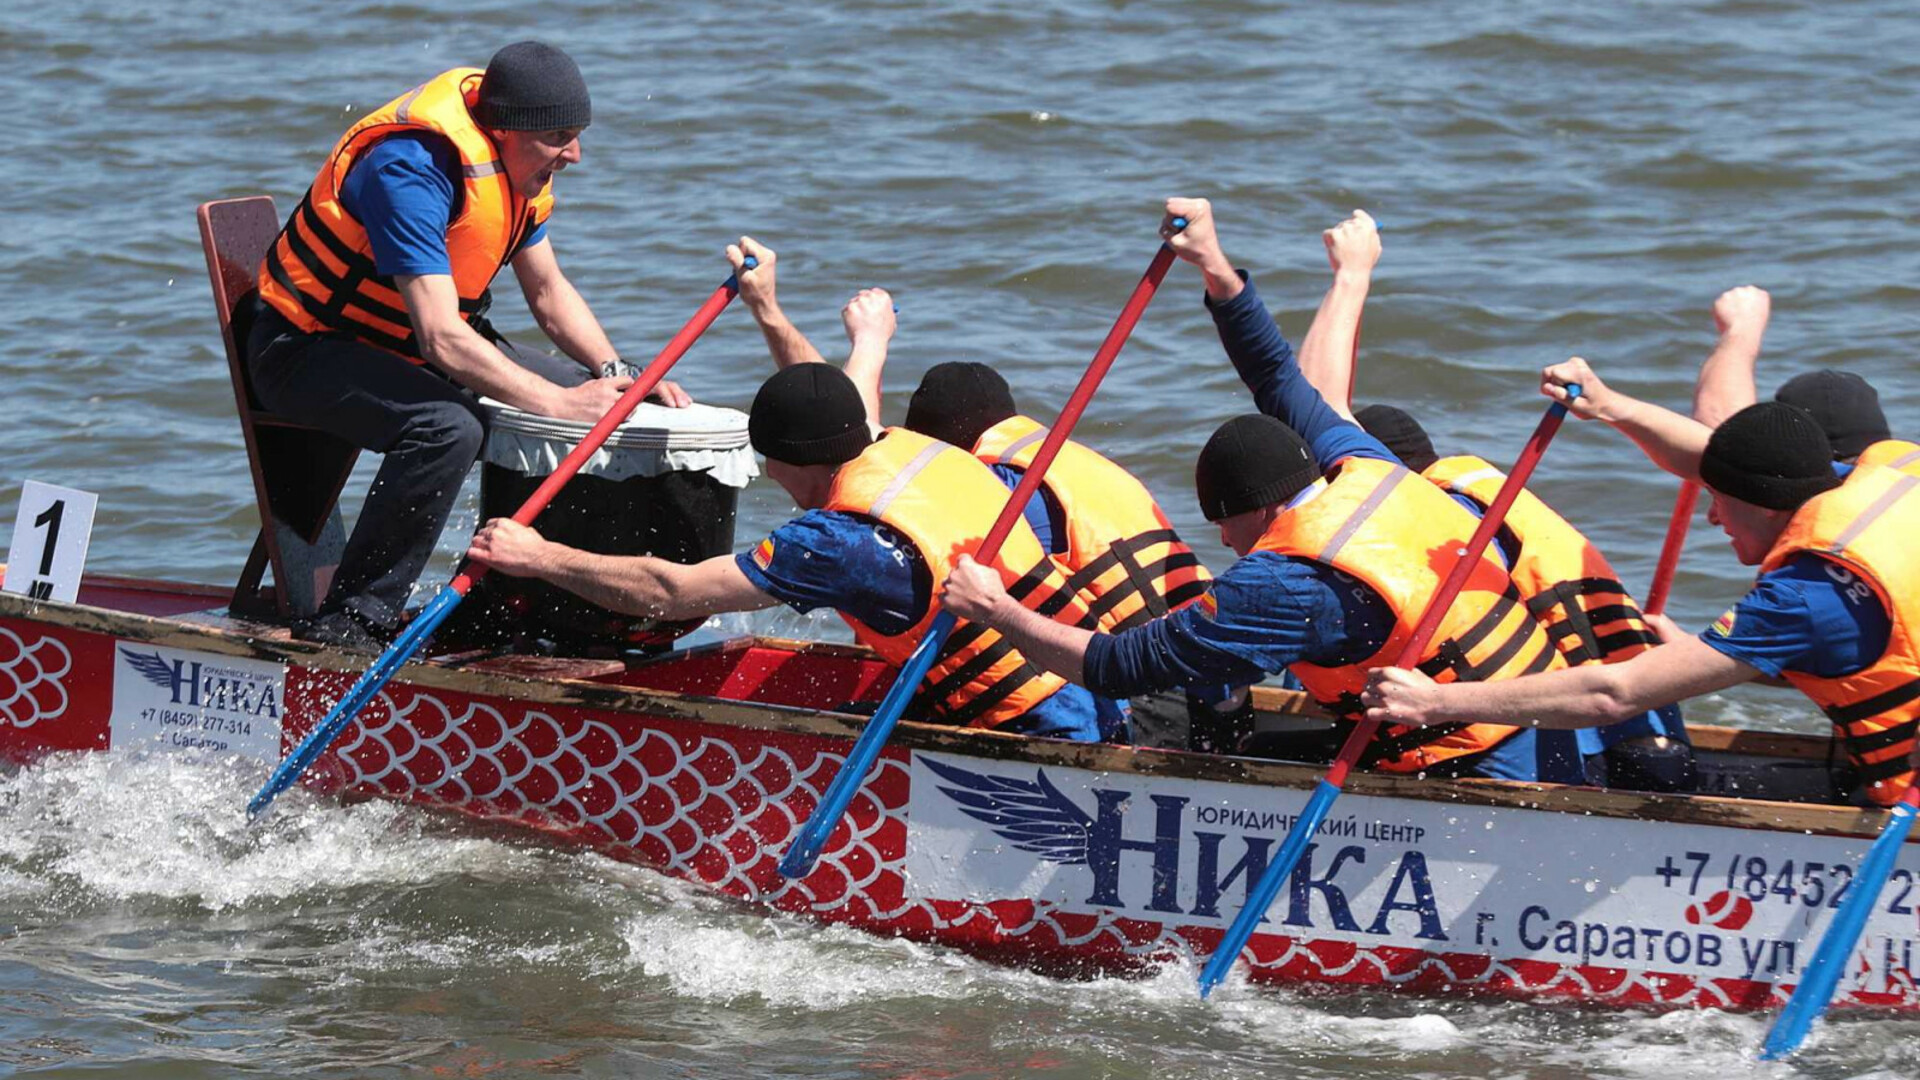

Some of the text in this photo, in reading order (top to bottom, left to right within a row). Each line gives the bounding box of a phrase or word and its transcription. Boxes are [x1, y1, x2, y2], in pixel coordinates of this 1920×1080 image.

[33, 499, 66, 577] 1
[141, 708, 156, 721] +7
[203, 715, 251, 736] 277-314
[1196, 805, 1425, 844] ЮРИДИЧЕКИЙ ЦЕНТР
[1086, 787, 1449, 942] НИКА
[1655, 851, 1711, 896] +7
[1727, 853, 1858, 908] (8452
[1518, 904, 1722, 967] Саратов
